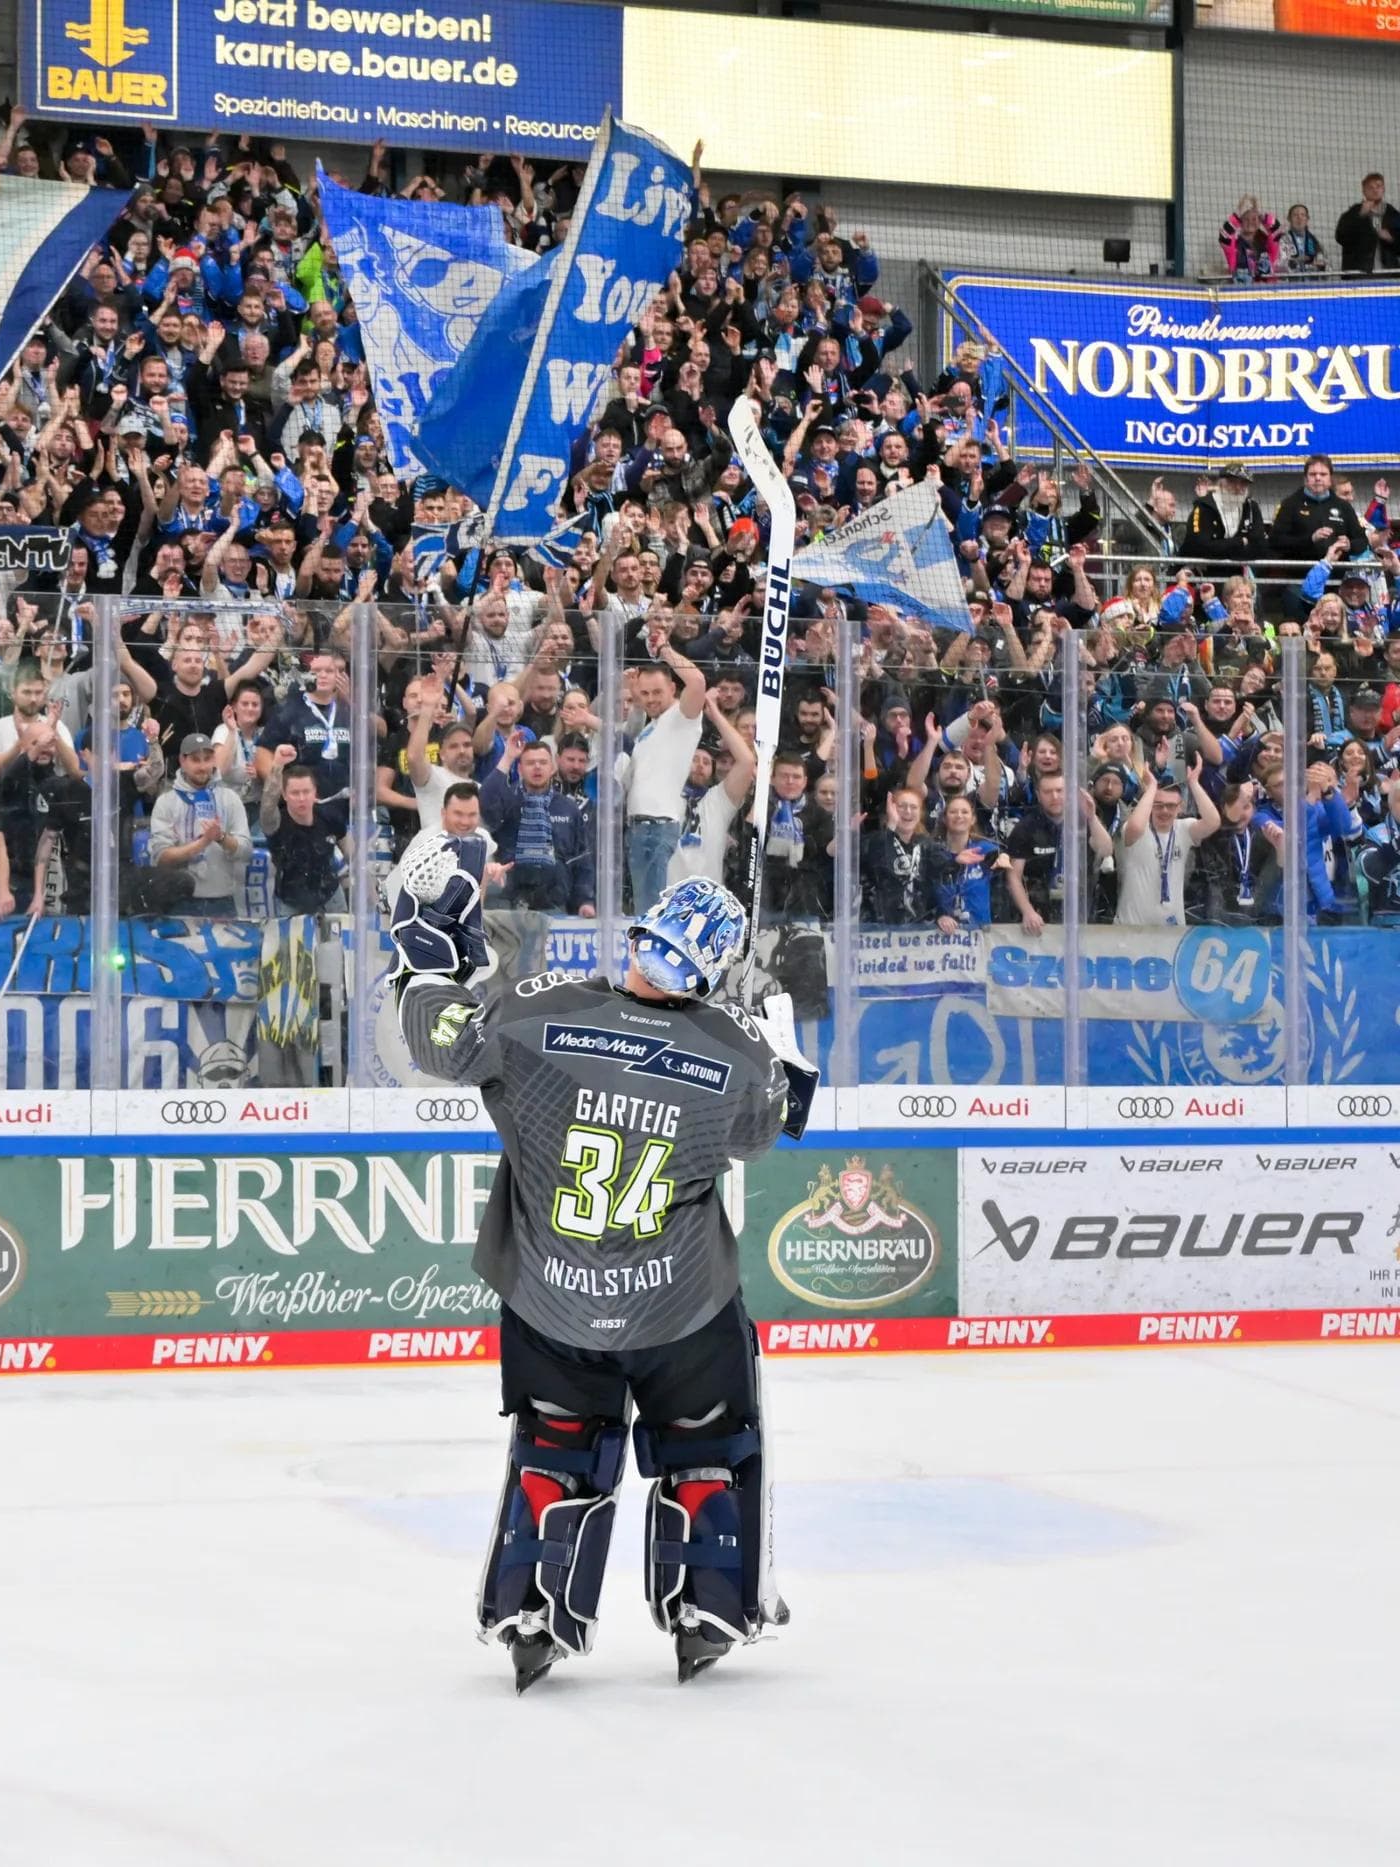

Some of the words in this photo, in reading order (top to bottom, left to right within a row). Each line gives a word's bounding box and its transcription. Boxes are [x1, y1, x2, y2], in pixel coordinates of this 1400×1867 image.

[214, 0, 298, 27] Jetzt
[306, 0, 492, 42] bewerben!
[215, 35, 518, 87] karriere.bauer.de
[47, 66, 167, 107] BAUER
[214, 93, 358, 123] Spezialtiefbau
[376, 106, 487, 132] Maschinen
[1127, 303, 1314, 341] Privatbrauerei
[1029, 336, 1400, 415] NORDBRÄU
[1125, 420, 1314, 449] INGOLSTADT
[761, 557, 790, 700] BÜCHL
[1189, 937, 1261, 1004] 64
[629, 1016, 672, 1028] BAUER
[681, 1061, 722, 1085] SATURN
[240, 1102, 309, 1122] Audi
[575, 1088, 681, 1138] GARTEIG
[969, 1097, 1030, 1117] Audi
[1186, 1097, 1245, 1117] Audi
[1001, 1160, 1088, 1174] BAUER
[1140, 1158, 1224, 1172] BAUER
[1275, 1157, 1358, 1171] BAUER
[552, 1124, 675, 1241] 34
[785, 1238, 925, 1262] HERRNBRÄU
[1049, 1212, 1364, 1260] BAUER
[544, 1255, 674, 1297] INGOLSTADT
[1369, 1269, 1390, 1281] IHR
[589, 1318, 628, 1330] JER53Y
[1320, 1312, 1400, 1336] PENN
